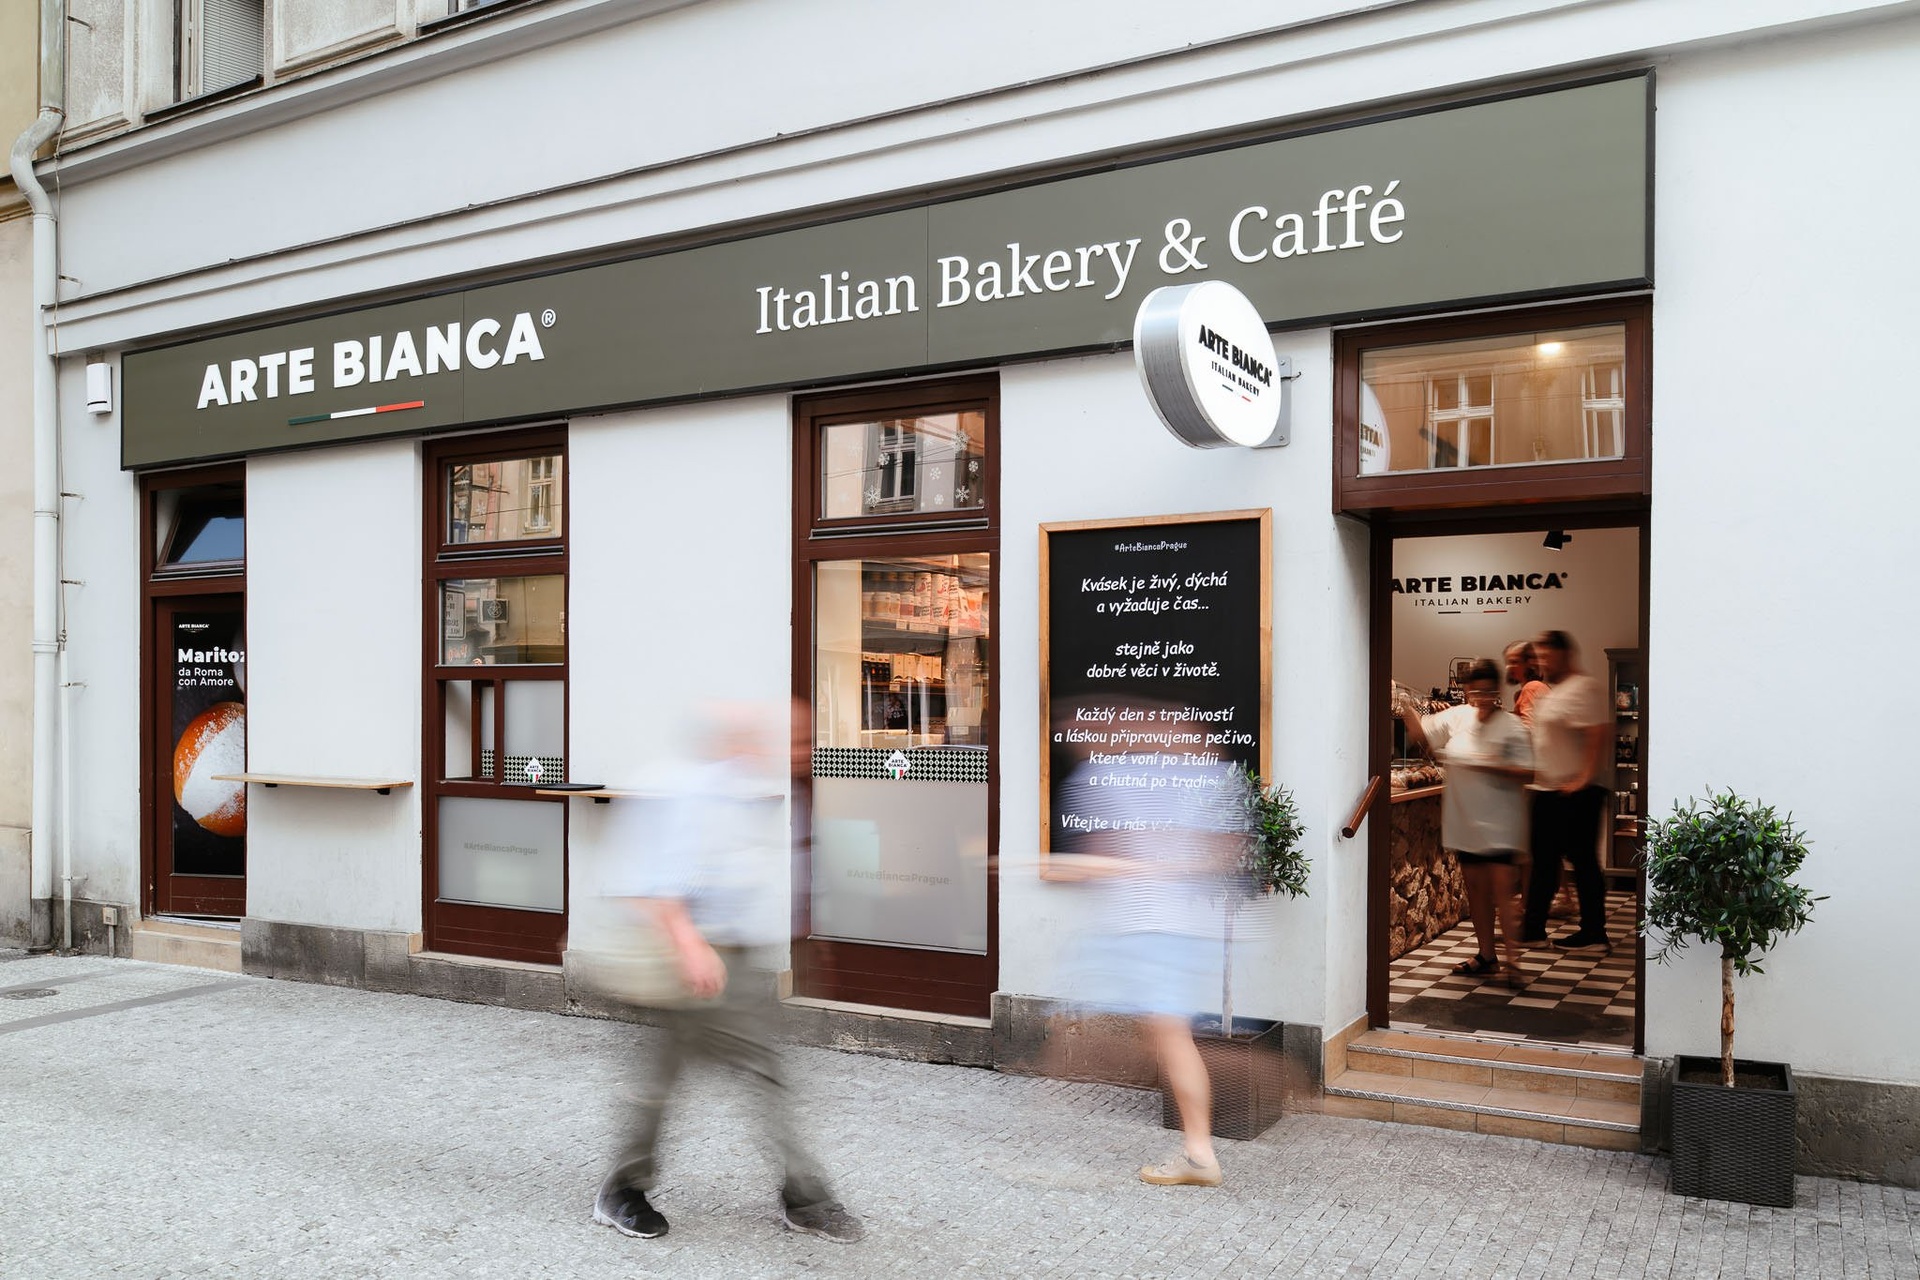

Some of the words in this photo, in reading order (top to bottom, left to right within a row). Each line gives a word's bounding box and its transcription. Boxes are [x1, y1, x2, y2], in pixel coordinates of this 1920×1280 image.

[755, 270, 920, 335] Italian
[936, 237, 1142, 309] Bakery
[1158, 217, 1209, 275] &
[1228, 180, 1406, 264] Caffé
[1198, 324, 1229, 361] ARTE
[196, 346, 315, 410] ARTE
[1211, 360, 1236, 383] ITALIAN
[1238, 376, 1260, 397] BAKERY
[1114, 540, 1188, 553] #ArteBiancaPrague
[1081, 576, 1128, 593] Kvásek
[1128, 576, 1145, 594] je
[1149, 573, 1181, 592] živý,
[1185, 571, 1229, 591] dýchá
[1391, 577, 1452, 594] ARTE
[1096, 602, 1105, 613] a
[1109, 597, 1169, 616] vyžaduje
[1173, 595, 1209, 610] čas...
[1414, 597, 1469, 606] ITALIAN
[1476, 596, 1532, 605] BAKERY
[1115, 641, 1160, 659] stejně
[1162, 640, 1194, 659] jako
[178, 667, 191, 676] da
[194, 667, 223, 676] Roma
[1086, 663, 1127, 678] dobré
[1130, 663, 1159, 678] věci
[1161, 666, 1170, 677] v
[1173, 661, 1221, 677] životě.
[178, 678, 197, 686] con
[200, 677, 234, 686] Amore
[1076, 708, 1116, 725] Každý
[1119, 707, 1144, 721] den
[1147, 711, 1156, 721] s
[1160, 707, 1235, 725] trpělivostí
[1054, 733, 1062, 743] a
[1066, 729, 1107, 743] láskou
[1110, 729, 1201, 747] připravujeme
[1205, 729, 1256, 747] pečivo,
[1089, 751, 1127, 765] které
[1131, 751, 1159, 766] voní
[1161, 755, 1178, 769] po
[1182, 752, 1218, 767] Itálii
[1089, 776, 1097, 786] a
[1101, 773, 1147, 787] chutná
[1150, 778, 1167, 791] po
[1061, 813, 1108, 832] Vítejte
[1112, 819, 1120, 830] u
[1124, 817, 1147, 831] nás
